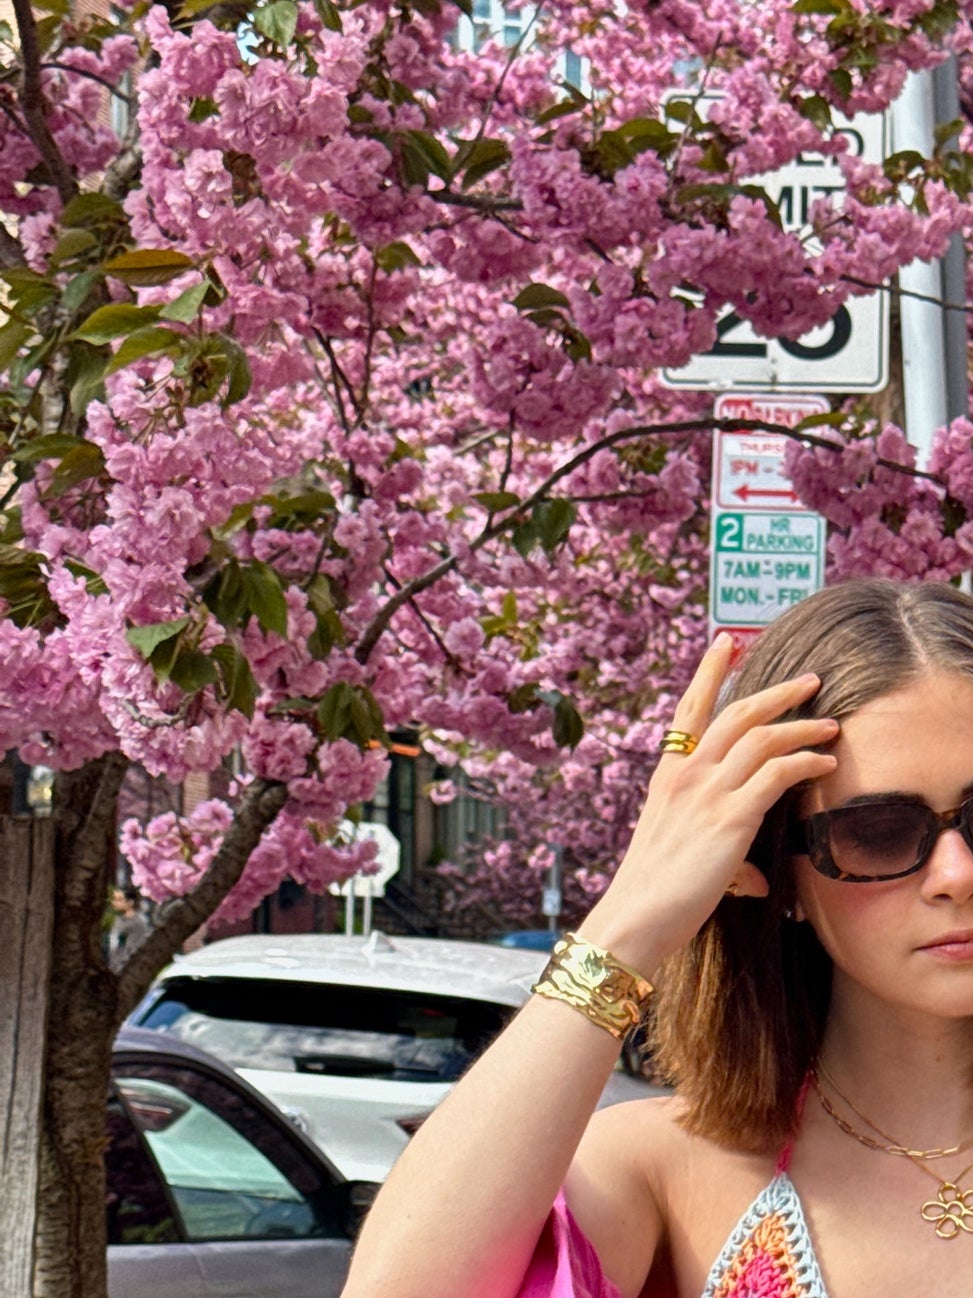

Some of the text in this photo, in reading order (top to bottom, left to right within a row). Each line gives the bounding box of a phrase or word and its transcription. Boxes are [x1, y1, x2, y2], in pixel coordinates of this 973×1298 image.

[720, 518, 790, 548] 2 HR
[747, 533, 815, 550] PARKING
